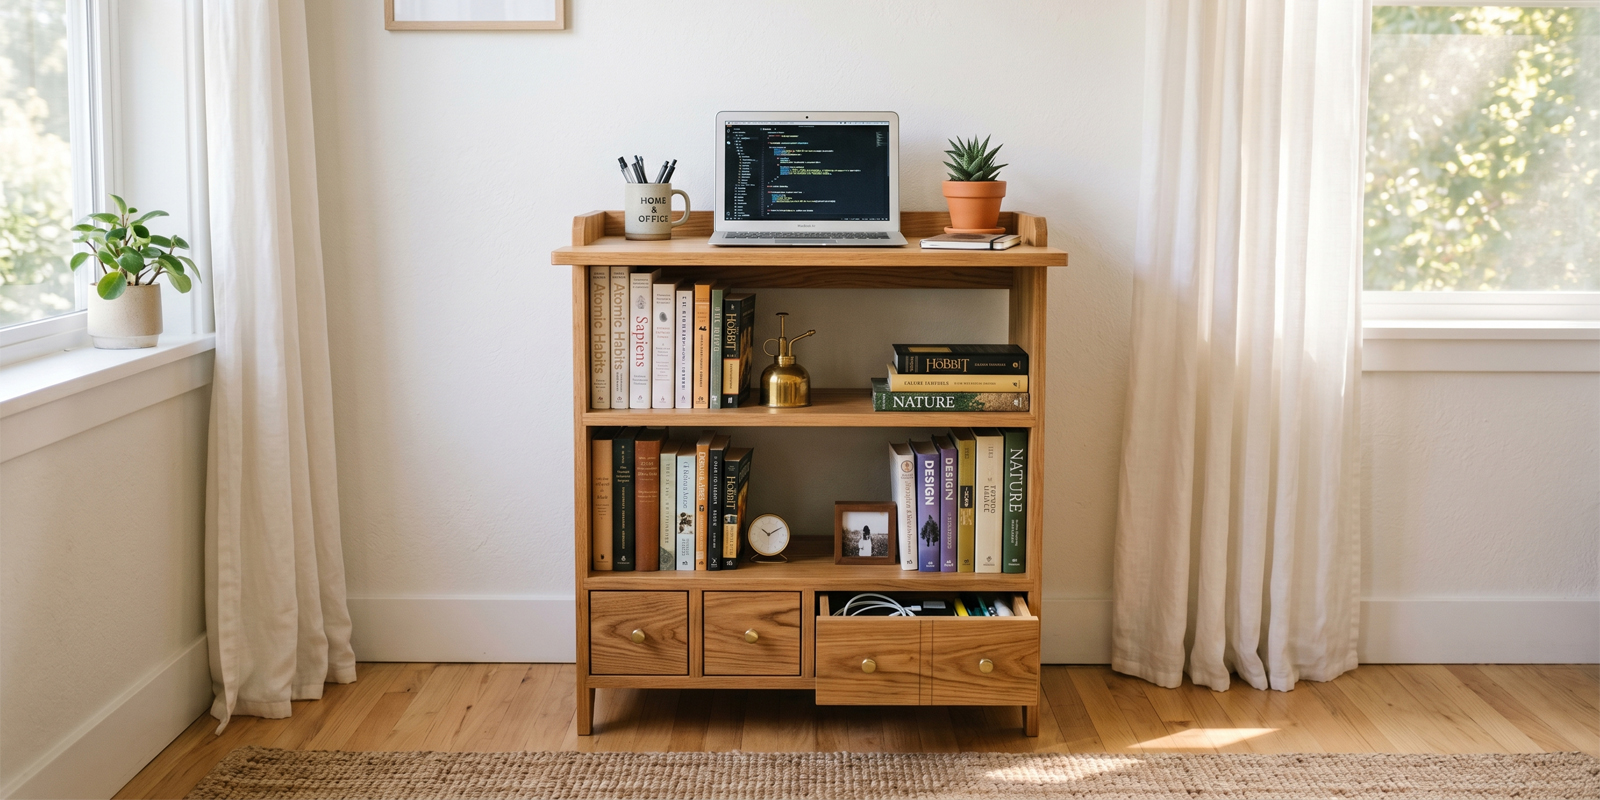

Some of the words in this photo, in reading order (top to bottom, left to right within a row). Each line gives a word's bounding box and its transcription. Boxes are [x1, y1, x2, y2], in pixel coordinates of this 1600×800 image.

[593, 282, 606, 329] Atomic
[613, 282, 625, 328] Atomic
[593, 333, 606, 374] Habits
[614, 331, 626, 370] Habits
[631, 316, 648, 367] Sapiens
[892, 396, 955, 408] NATURE
[924, 460, 935, 506] DESIGN
[1009, 448, 1024, 513] NATURE
